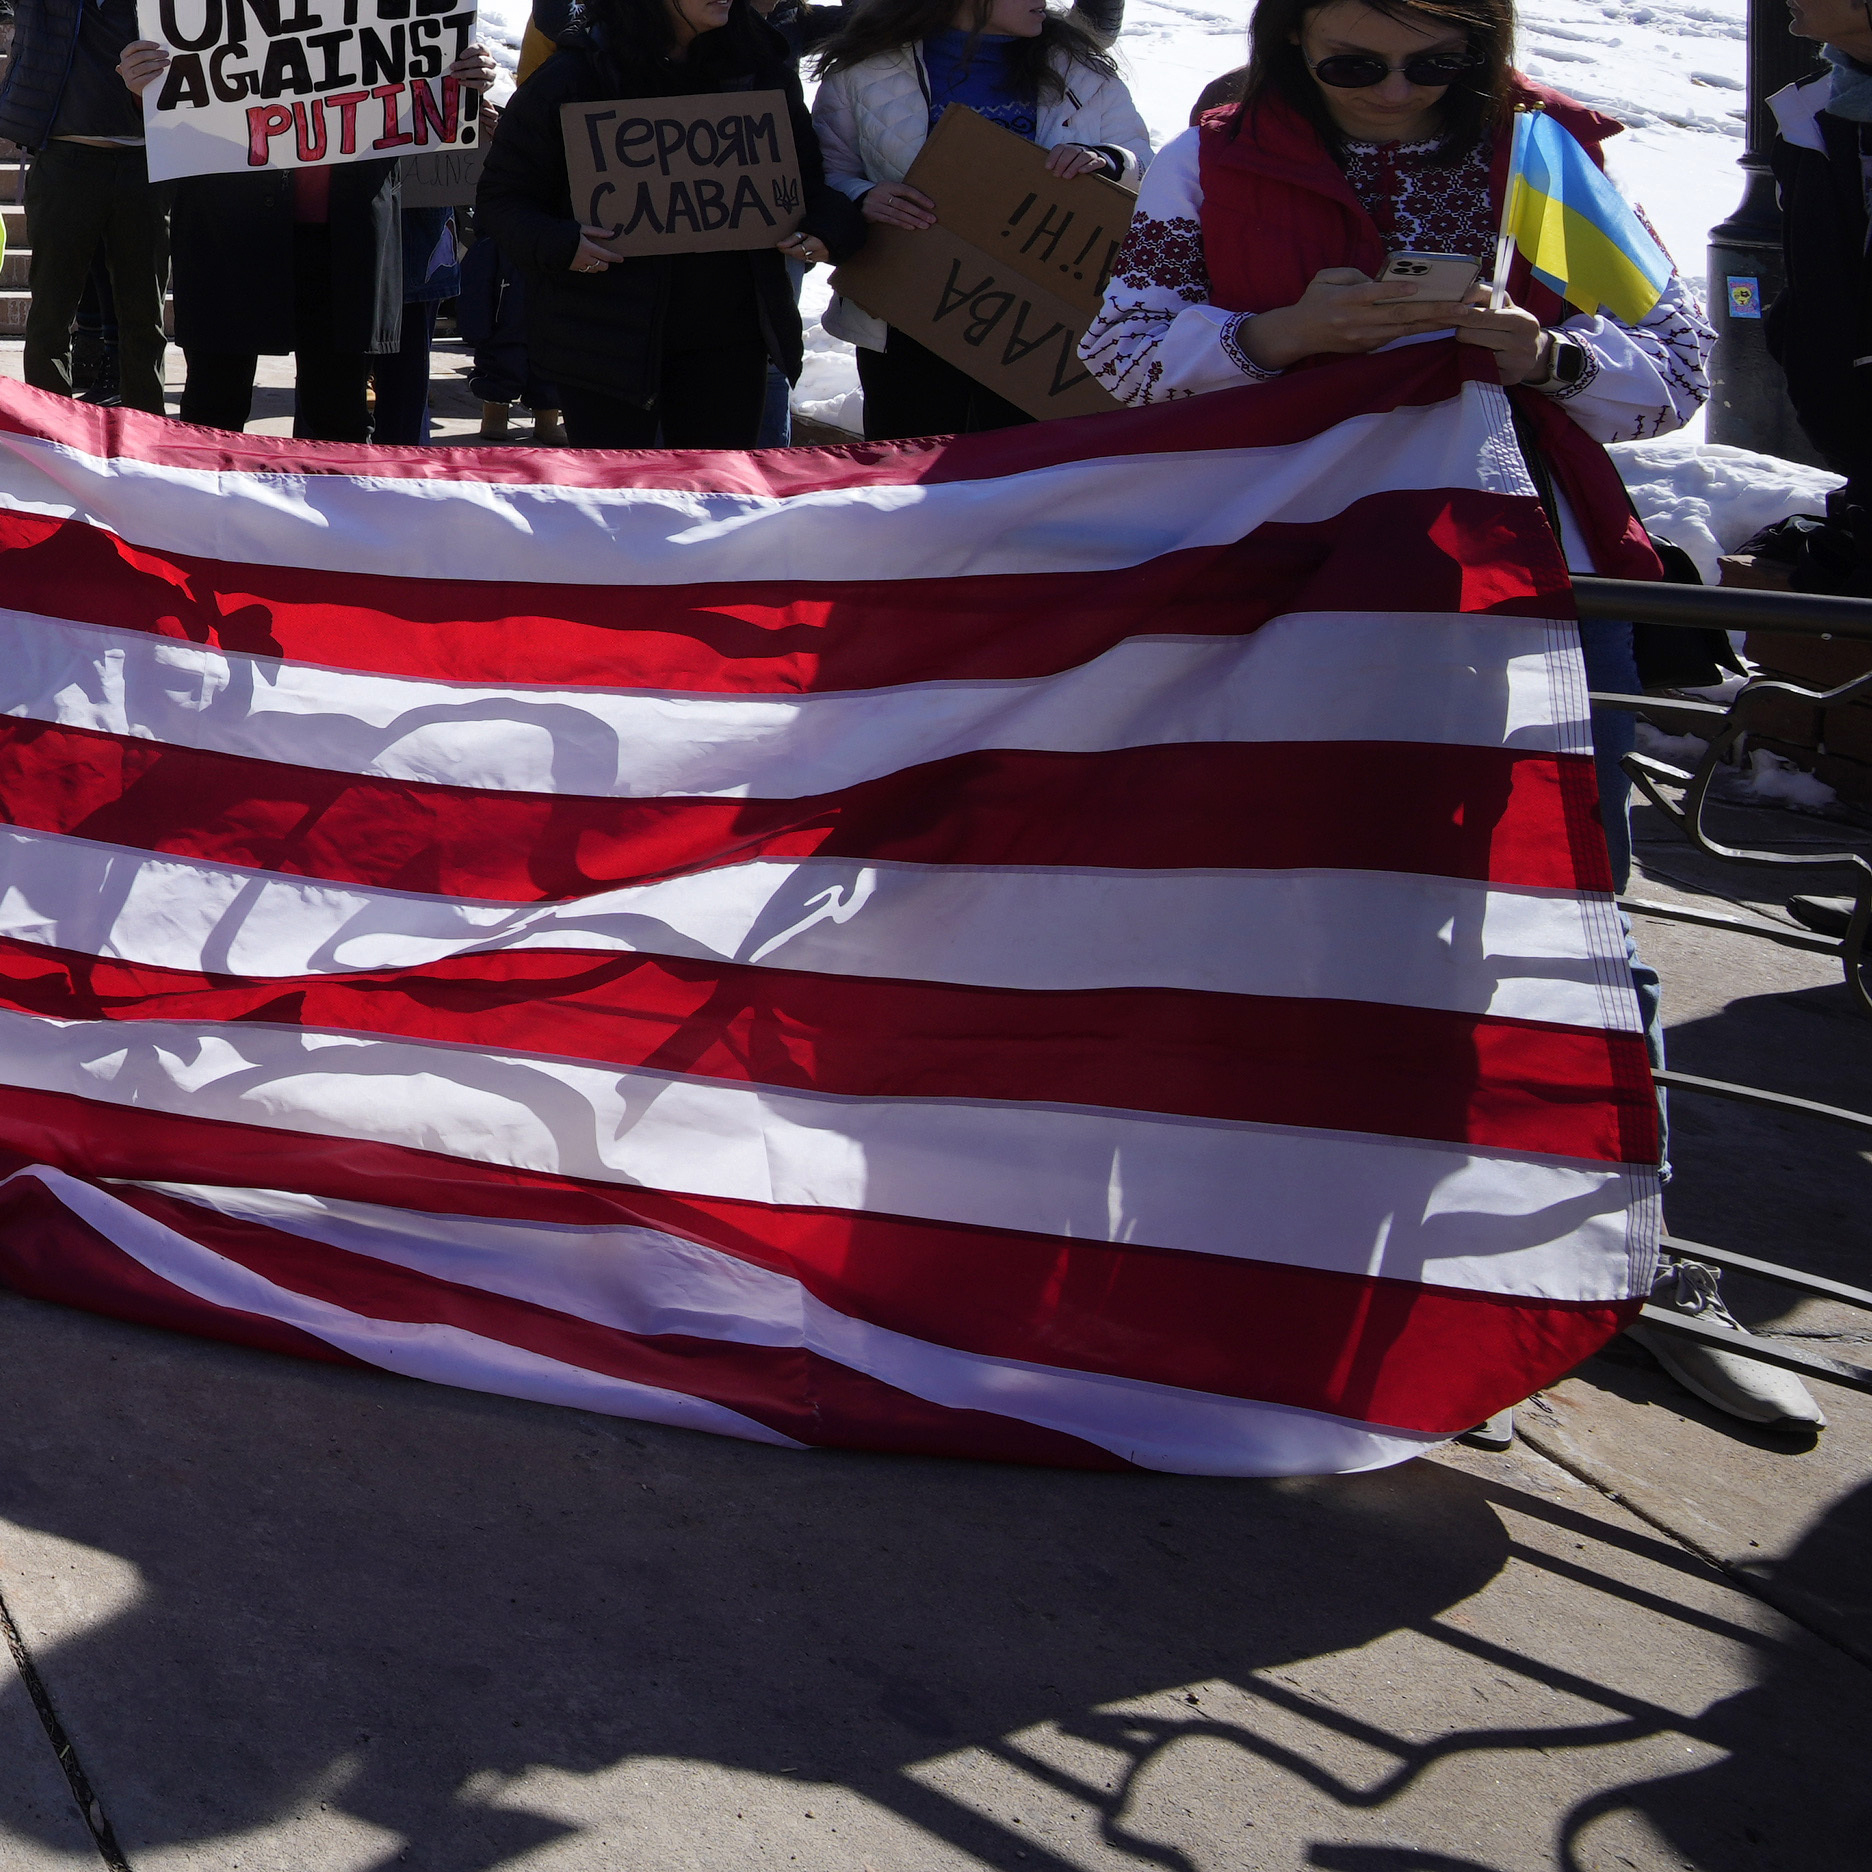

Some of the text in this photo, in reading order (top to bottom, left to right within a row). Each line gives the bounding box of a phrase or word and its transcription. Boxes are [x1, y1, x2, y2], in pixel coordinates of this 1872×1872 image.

[156, 9, 478, 111] AGAINST
[245, 74, 479, 167] PUTIN!
[589, 175, 778, 242] СЛАВА
[931, 258, 1096, 398] ЛАВА
